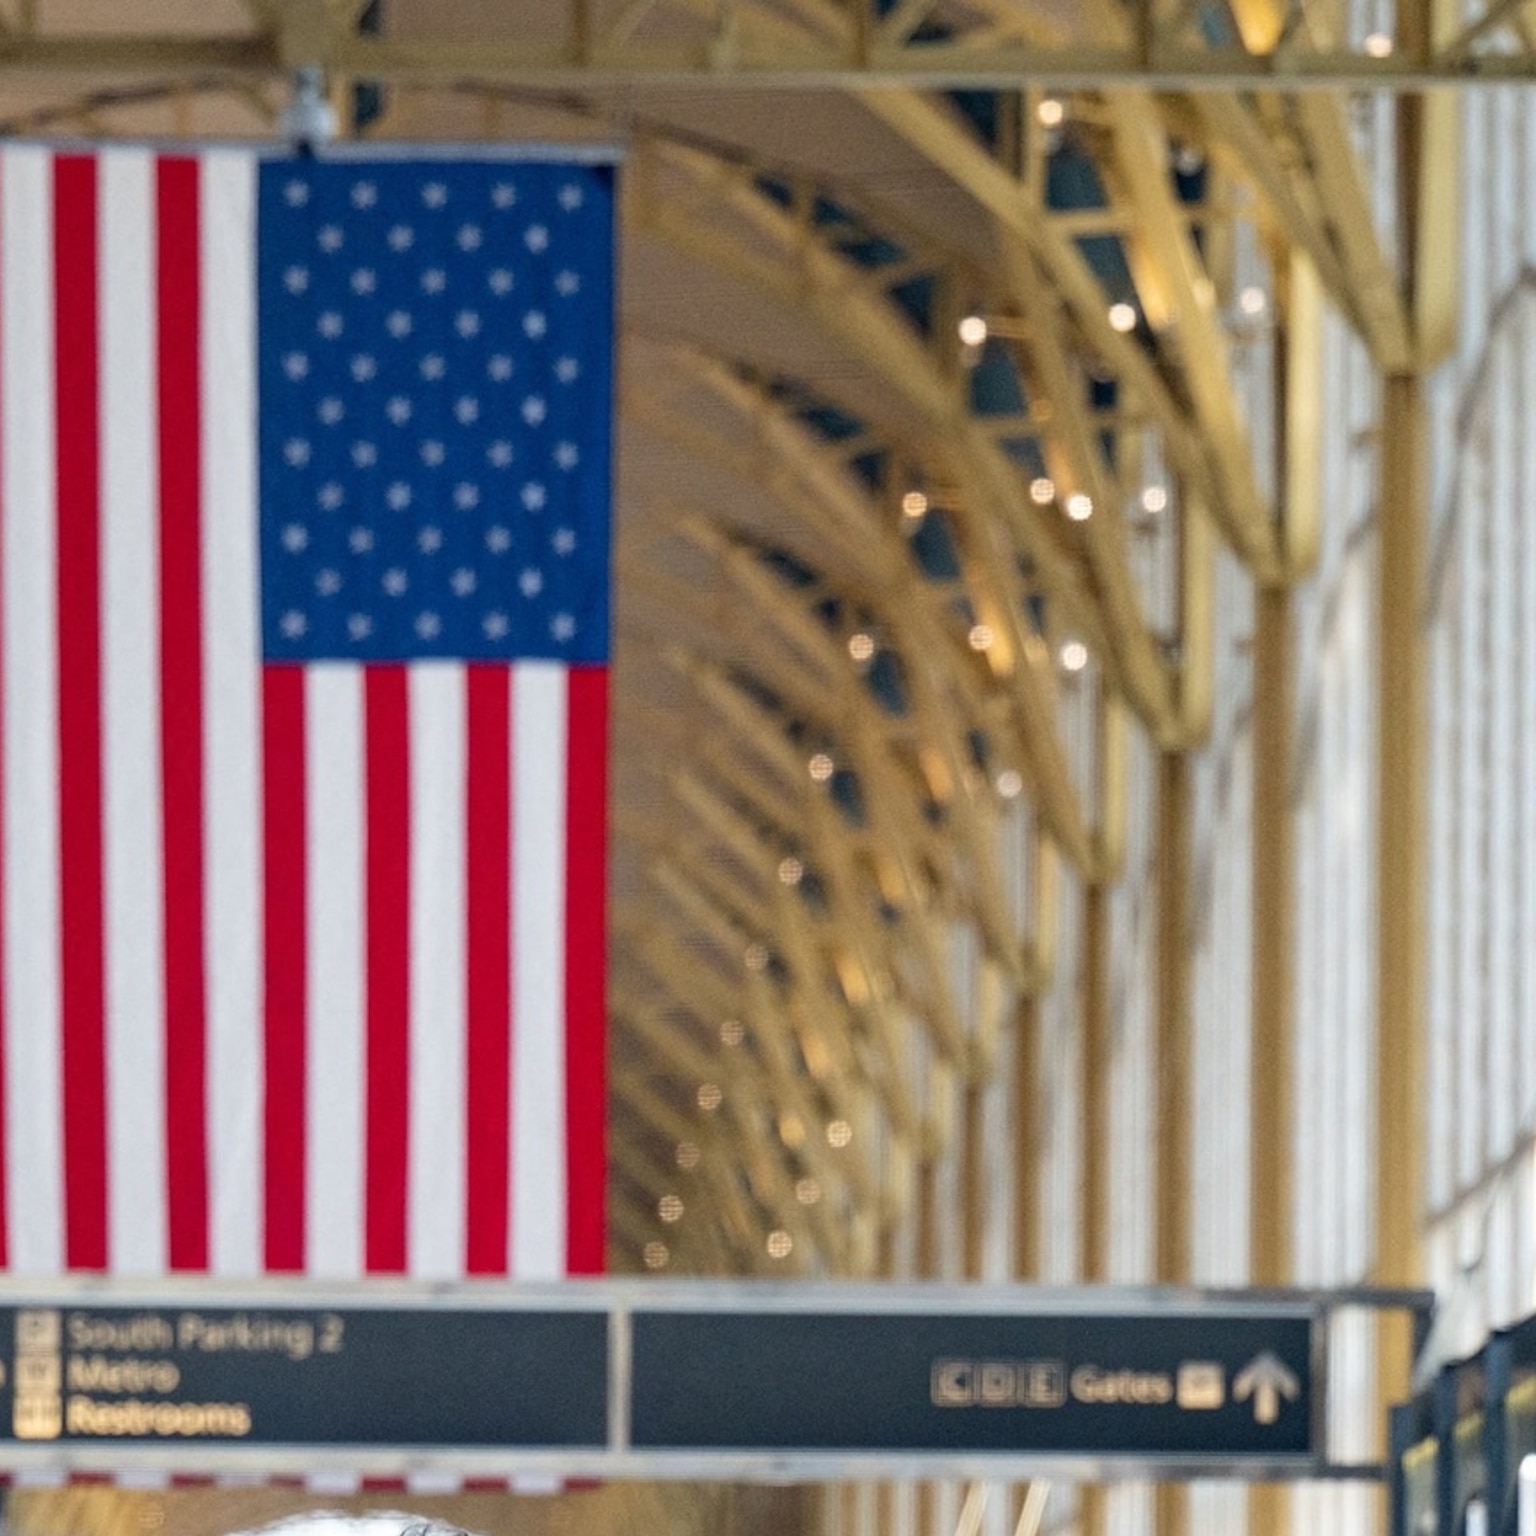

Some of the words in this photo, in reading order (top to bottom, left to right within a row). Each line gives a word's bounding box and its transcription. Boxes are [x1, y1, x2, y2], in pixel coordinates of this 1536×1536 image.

[68, 1311, 174, 1351] South
[177, 1312, 316, 1361] Parking
[318, 1312, 346, 1354] 2
[68, 1353, 180, 1394] Metro
[1070, 1363, 1173, 1405] Gates
[67, 1394, 252, 1437] Restrooms
